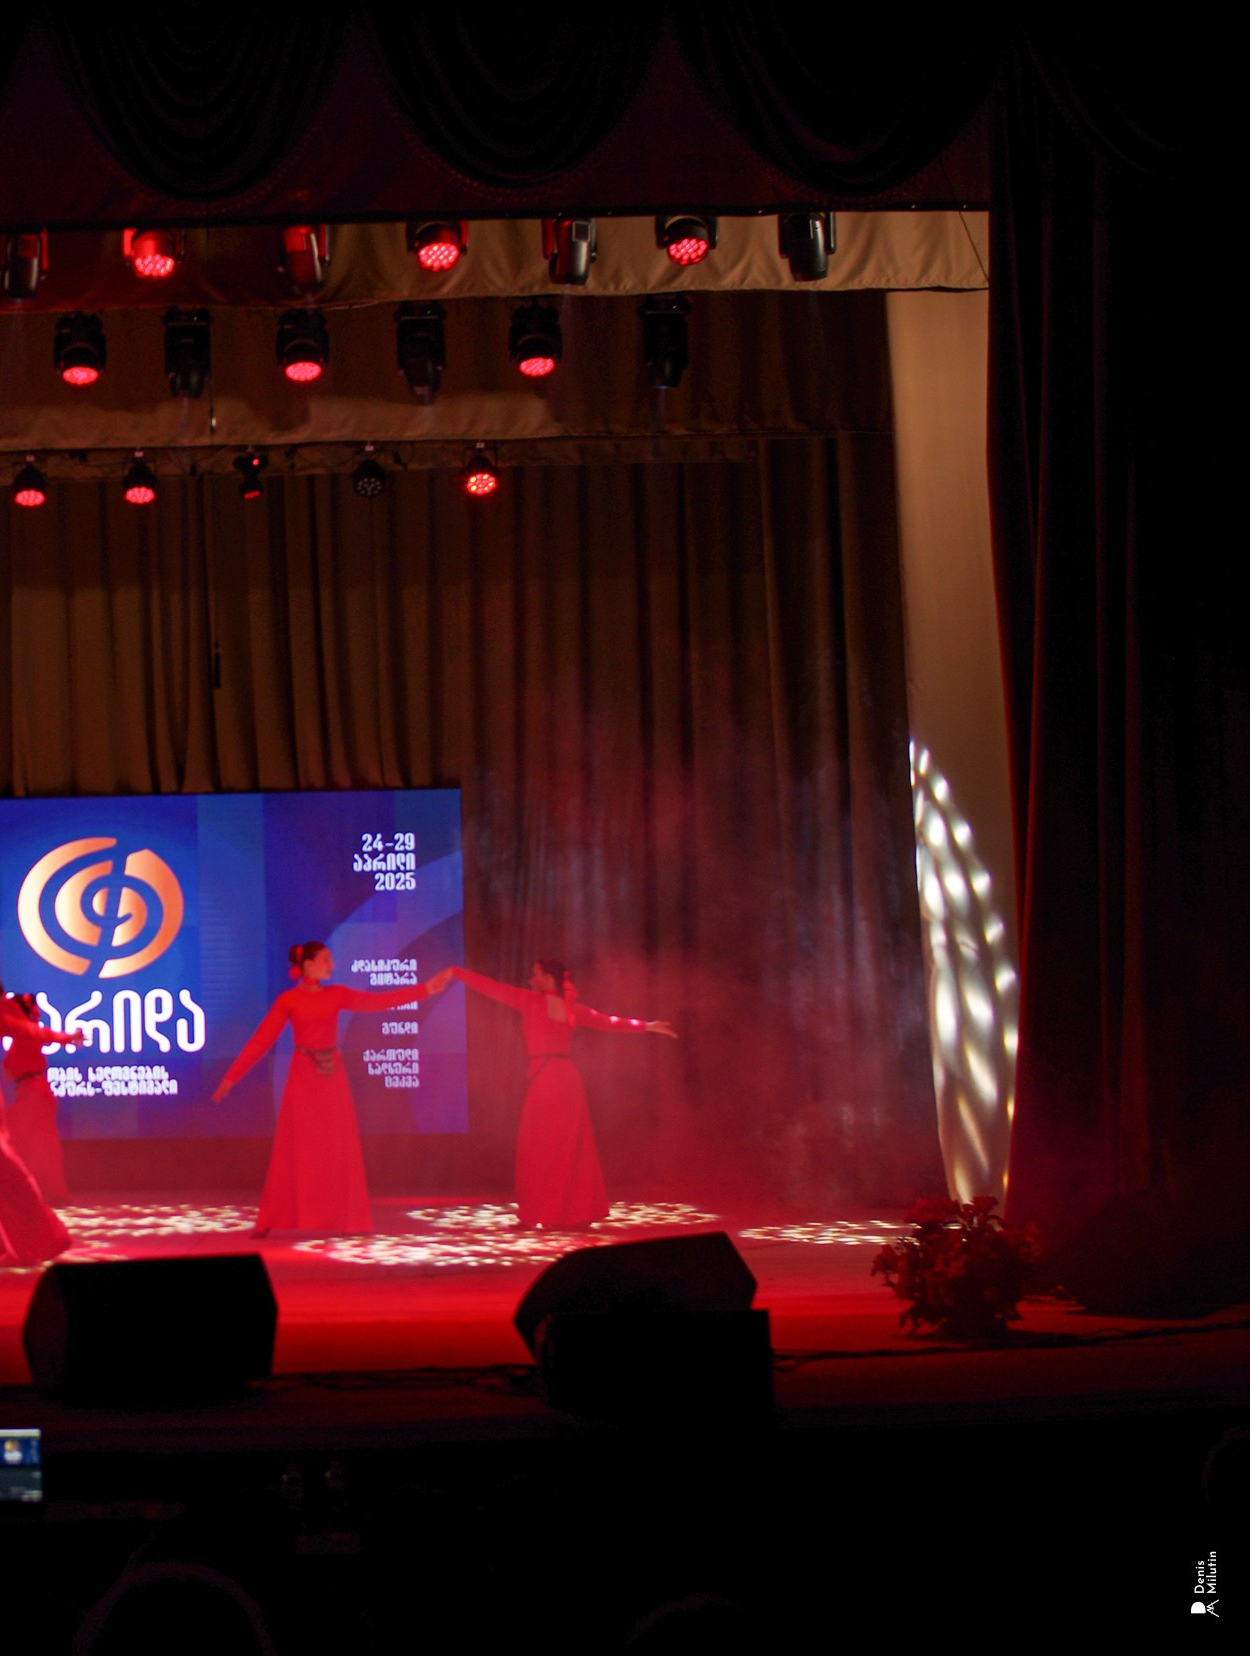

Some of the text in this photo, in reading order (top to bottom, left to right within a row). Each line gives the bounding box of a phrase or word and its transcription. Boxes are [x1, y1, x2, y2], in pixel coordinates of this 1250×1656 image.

[361, 832, 416, 852] 24-29
[353, 852, 416, 872] აპრილი
[374, 872, 417, 891] 2025
[350, 958, 417, 973] კლასიკური
[369, 972, 418, 986] გიტარა
[2, 988, 206, 1054] არიდა
[381, 1021, 419, 1035] გუნდი
